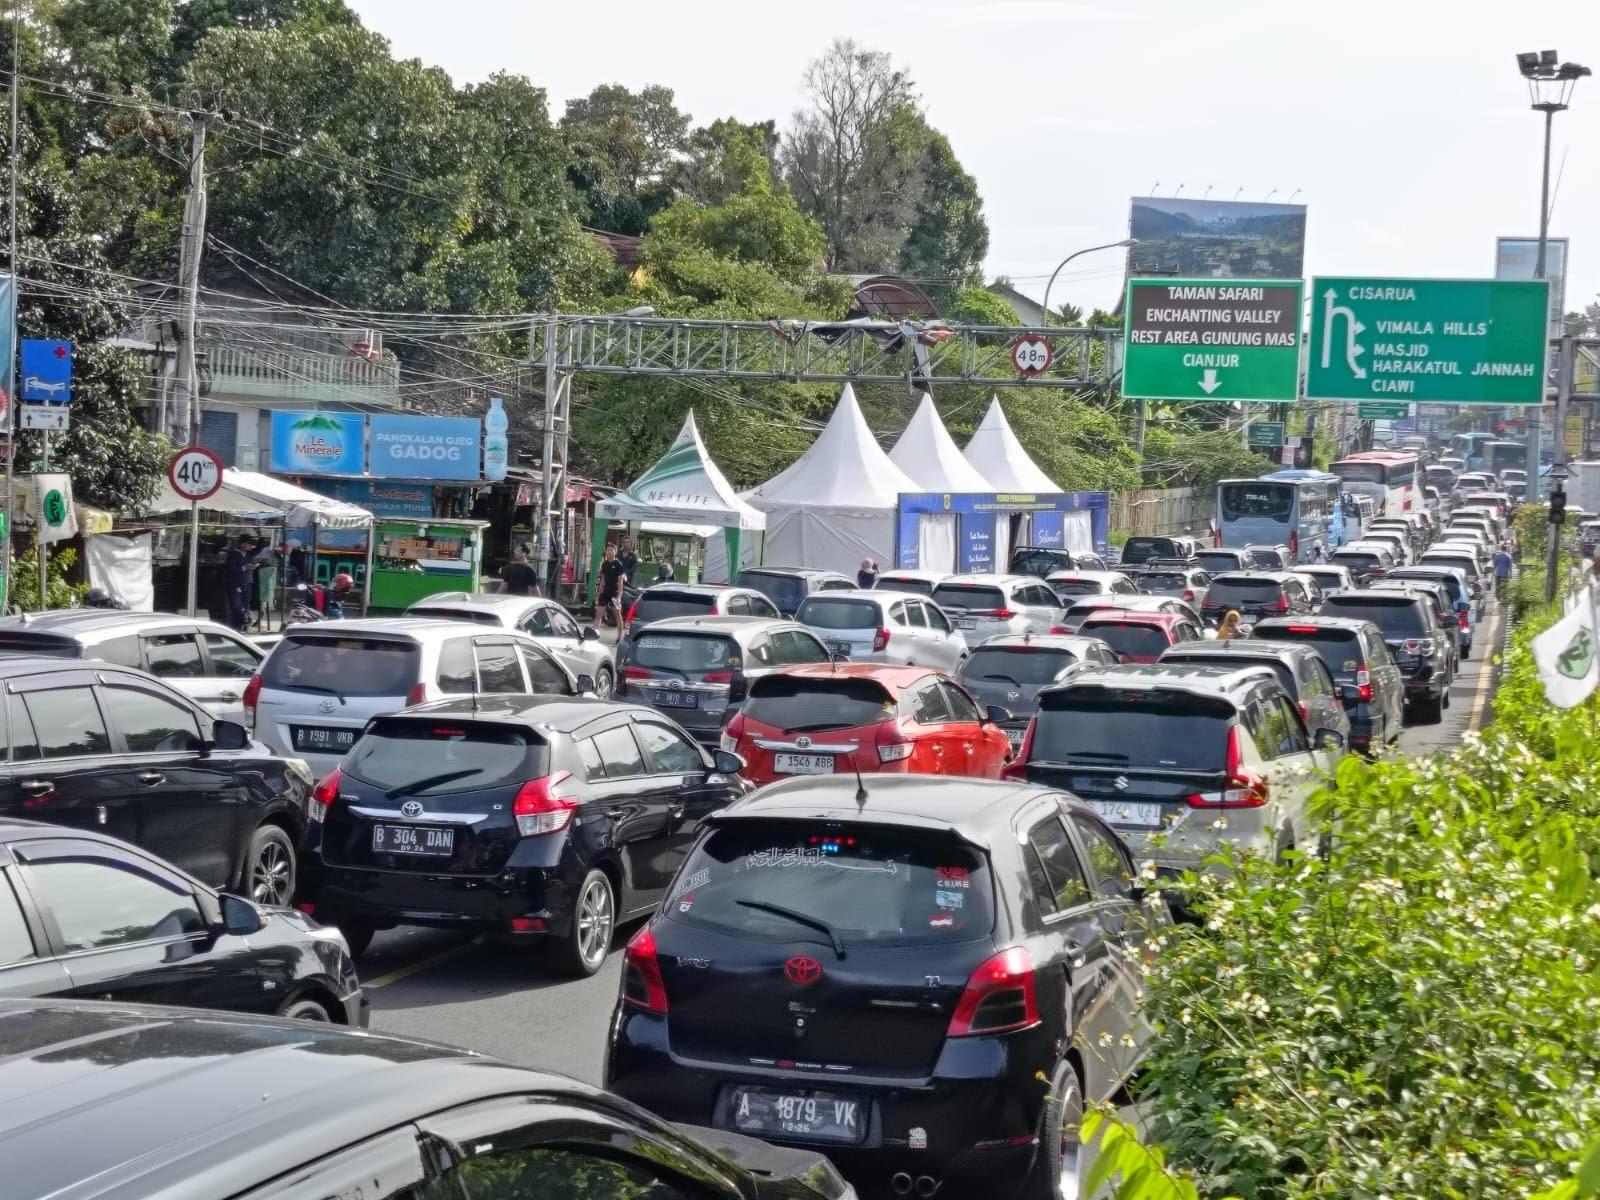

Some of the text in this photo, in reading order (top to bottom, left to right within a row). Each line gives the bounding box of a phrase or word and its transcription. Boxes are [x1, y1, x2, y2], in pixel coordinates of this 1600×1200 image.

[1168, 286, 1264, 301] TAMAN SAFARI
[1349, 287, 1416, 301] CISARUA
[1146, 308, 1282, 324] ENCHANTING VALLEY
[1376, 320, 1487, 336] VIMALA HILLS
[1131, 330, 1296, 346] REST AREA GUNUNG MAS
[1373, 343, 1430, 357] MASJID
[1183, 353, 1240, 368] CIANJUR
[1372, 360, 1535, 377] HARAKATUL JANNAH
[1371, 379, 1416, 393] CIAWI
[311, 435, 326, 446] Le
[376, 432, 473, 446] PANGKALAN OJEG
[295, 444, 342, 457] Minerale
[390, 446, 461, 461] GADOG
[177, 459, 214, 483] 40 km
[648, 490, 711, 505] NESLITE
[297, 729, 304, 741] B
[310, 730, 329, 742] 1591
[776, 755, 783, 766] F
[376, 827, 452, 847] B 304 DAN
[738, 1093, 856, 1127] A 1879 VK
